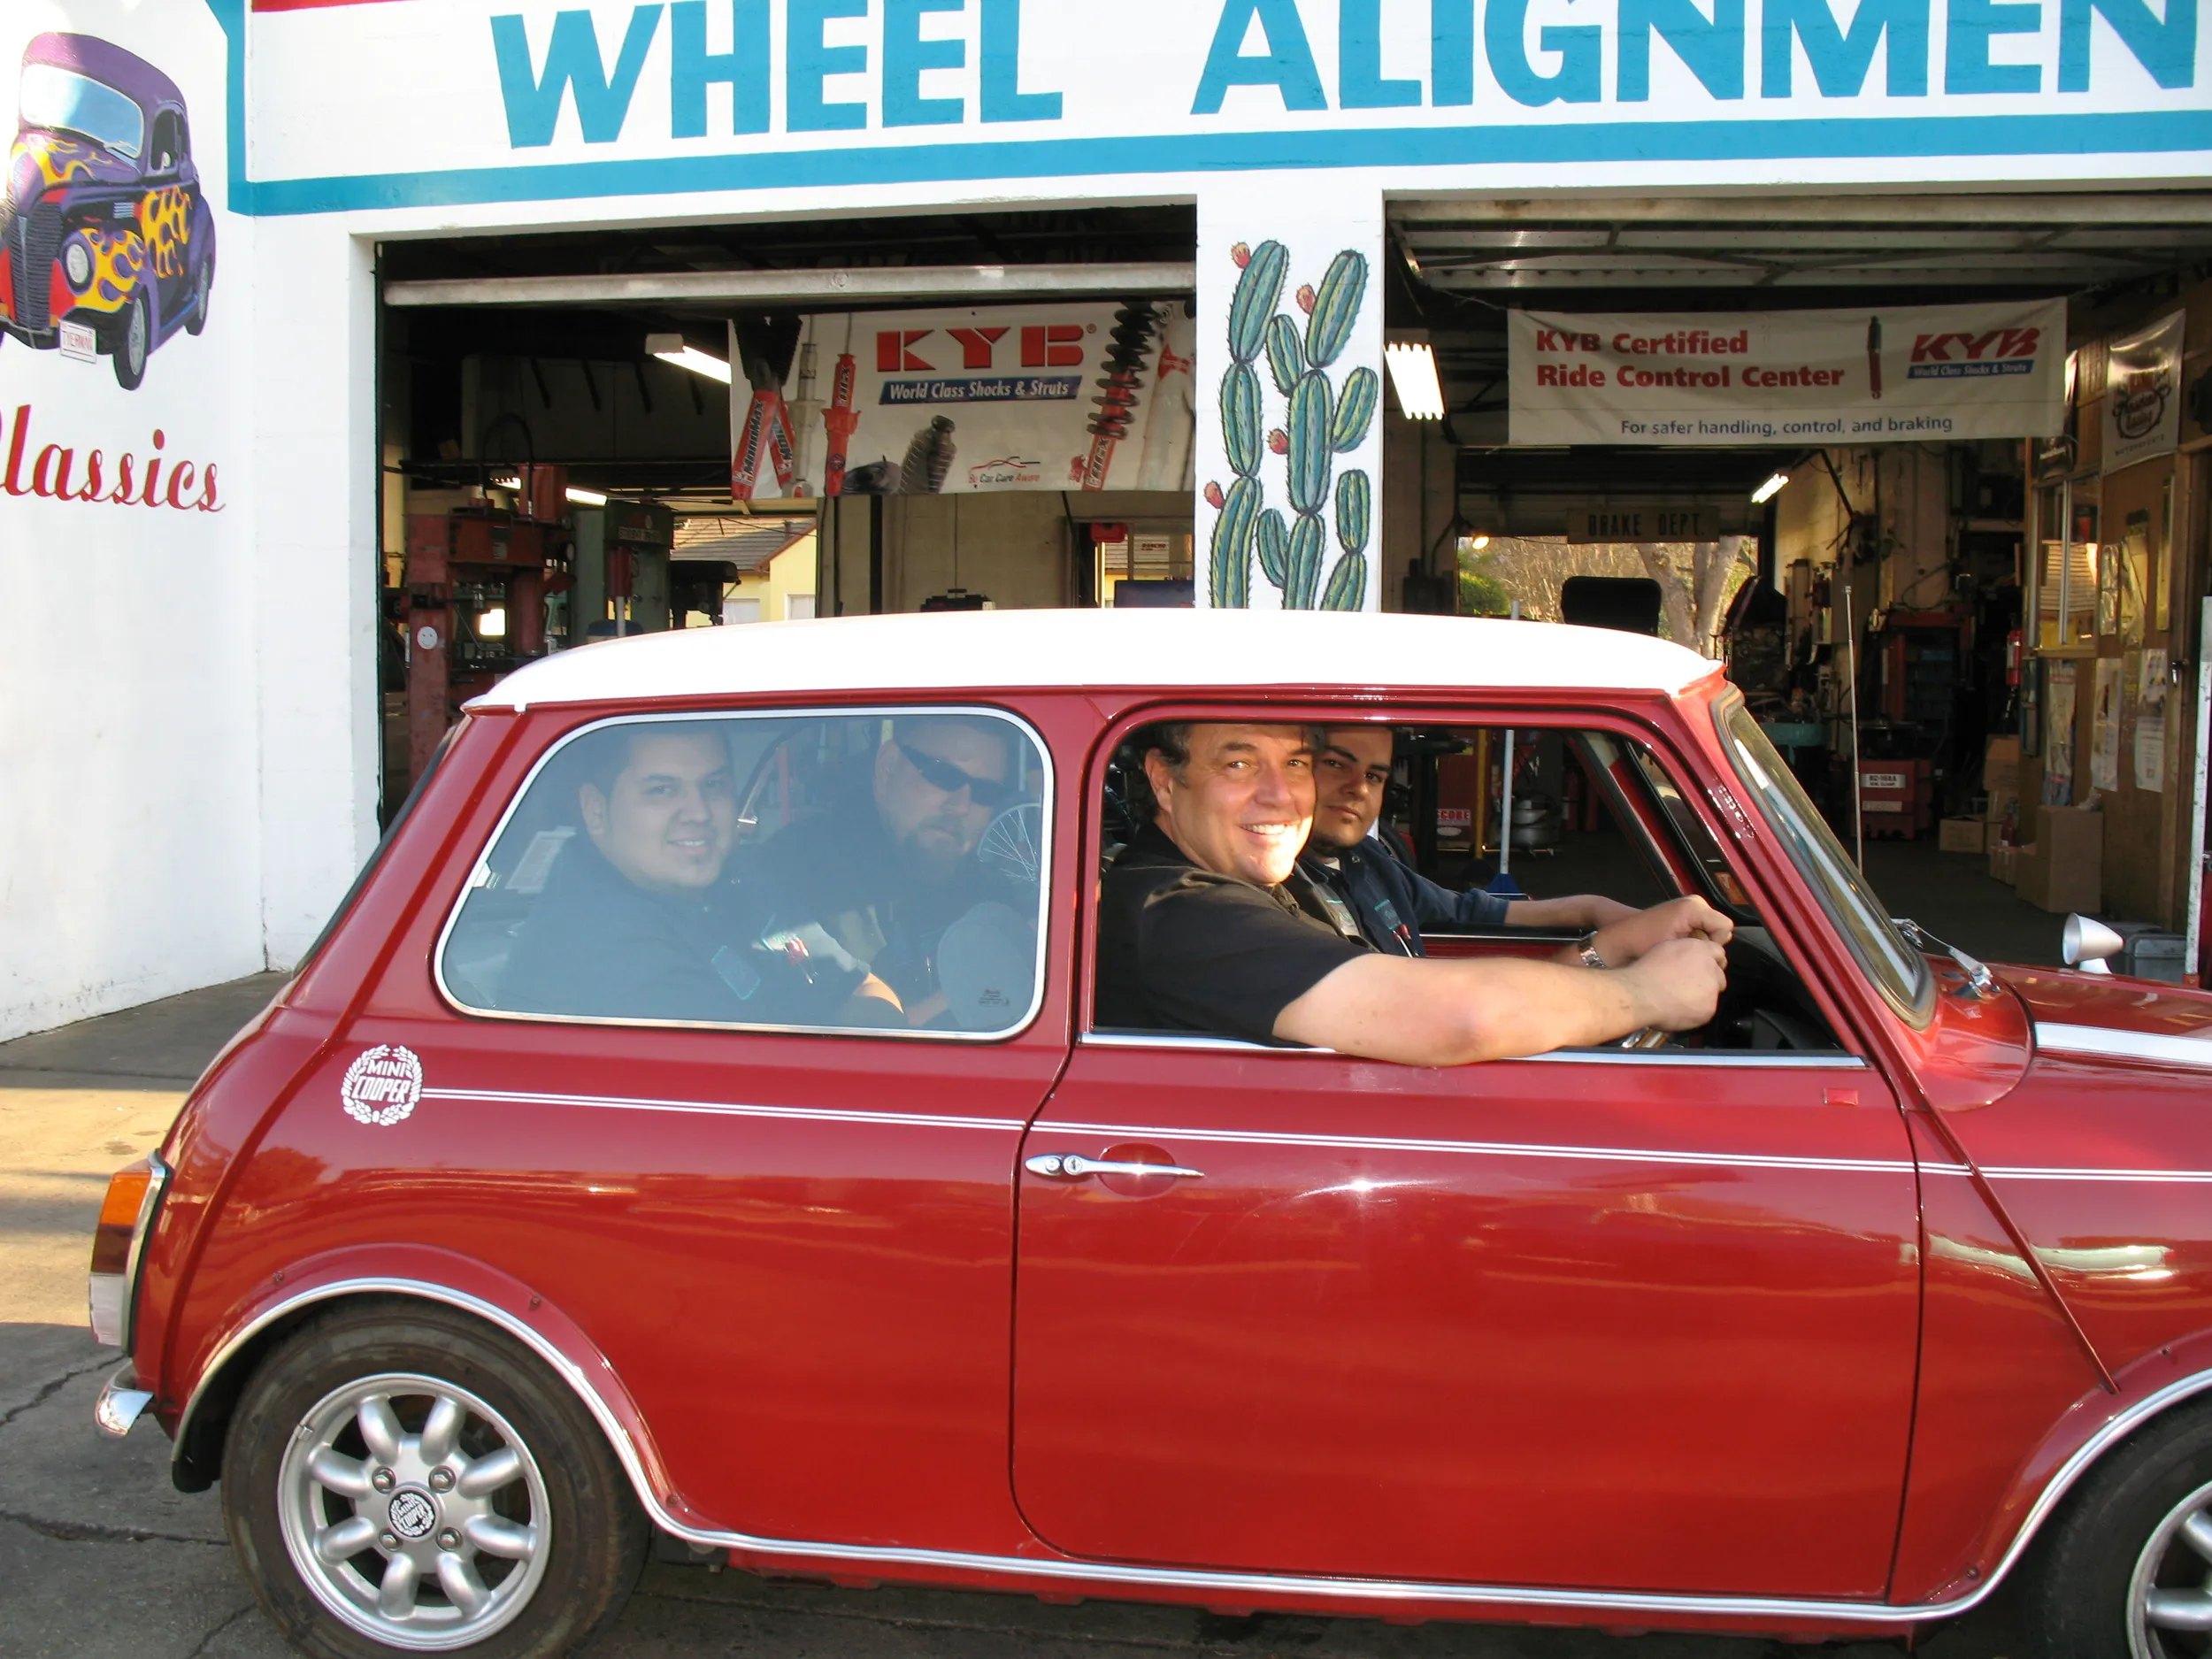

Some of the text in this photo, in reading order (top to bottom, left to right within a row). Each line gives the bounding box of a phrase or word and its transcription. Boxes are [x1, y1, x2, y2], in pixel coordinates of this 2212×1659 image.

[490, 0, 1062, 149] WHEEL
[877, 325, 1084, 372] KYB
[1536, 330, 1748, 354] KYB Certified
[1910, 327, 2040, 362] KYB
[1537, 364, 1846, 388] Ride Control Center
[889, 379, 1070, 399] World Class Shocks & Struts
[1621, 416, 1953, 438] For safer handling, control, and braking
[0, 404, 227, 512] lassics
[1588, 514, 1641, 535] BRAKE
[366, 1059, 406, 1078] MINI
[351, 1075, 412, 1103] COOPER
